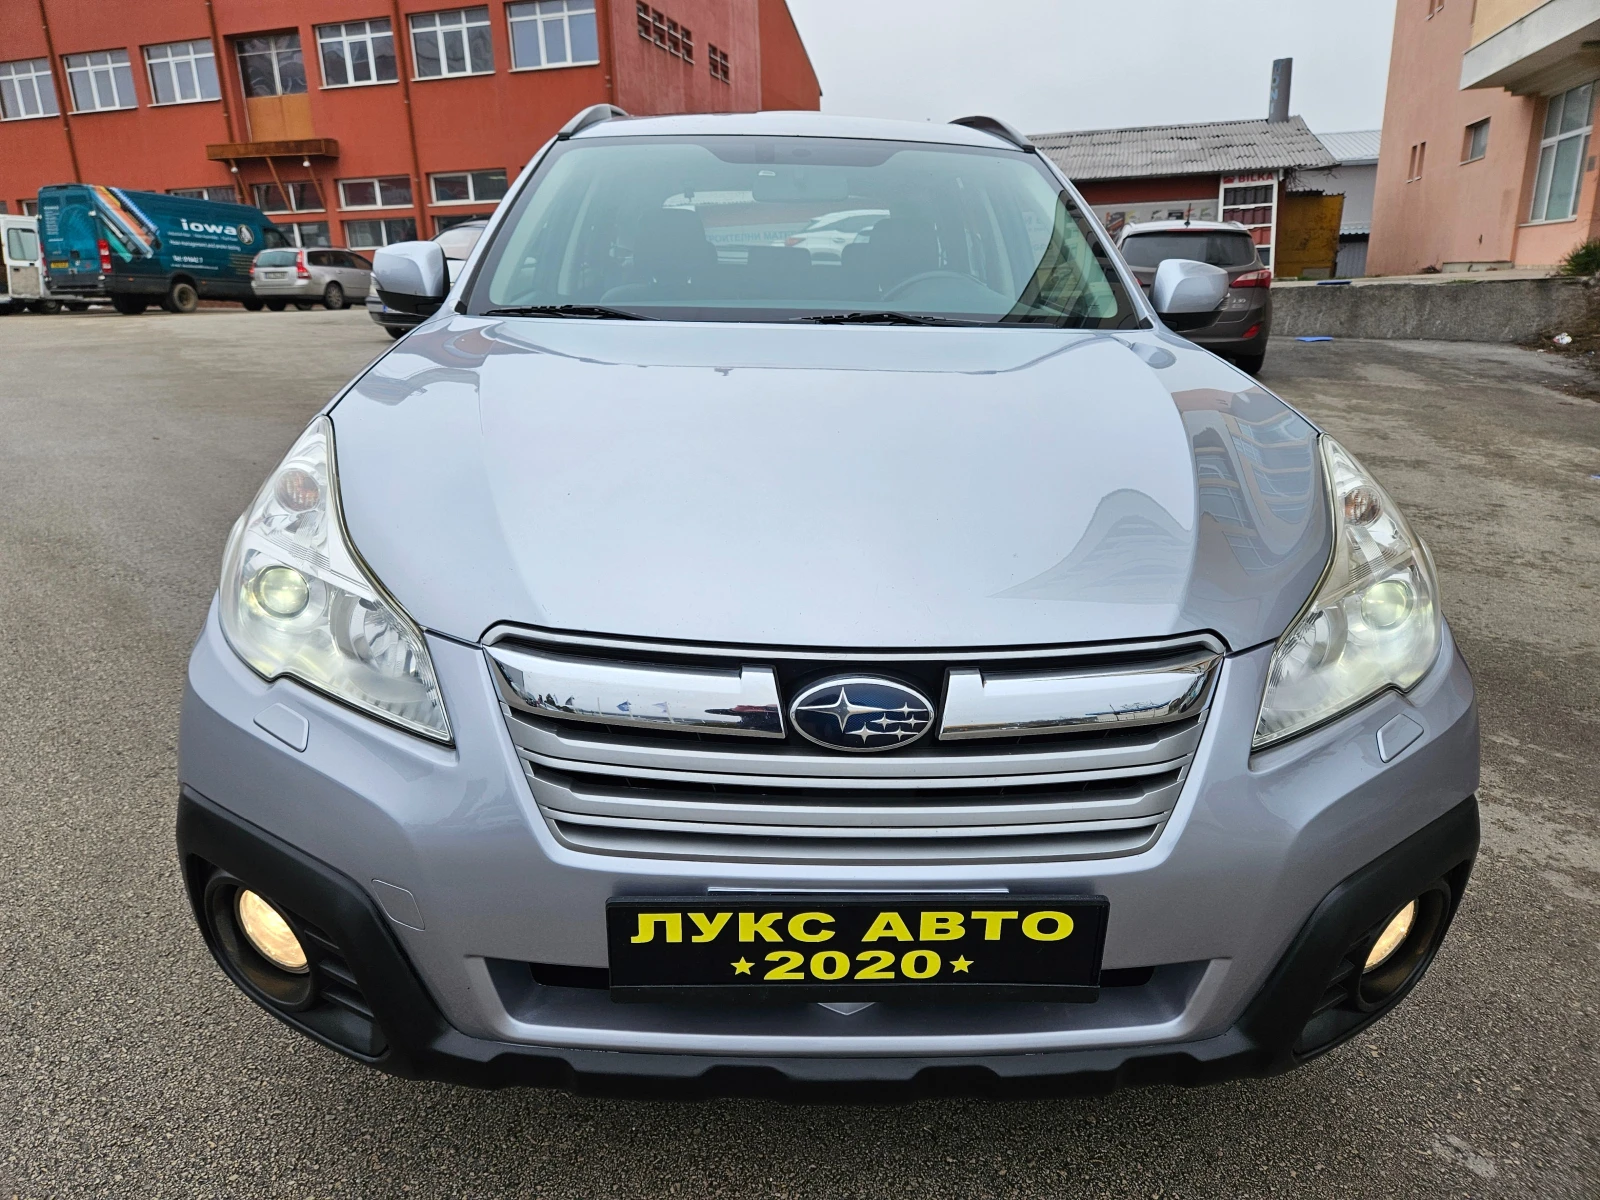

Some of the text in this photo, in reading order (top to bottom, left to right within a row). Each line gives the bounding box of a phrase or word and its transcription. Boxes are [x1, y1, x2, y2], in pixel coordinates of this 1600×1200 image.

[1238, 172, 1274, 183] BILKA
[180, 217, 237, 236] iowa
[630, 910, 1075, 943] ЛУКС АВТО
[763, 949, 942, 981] 2020
